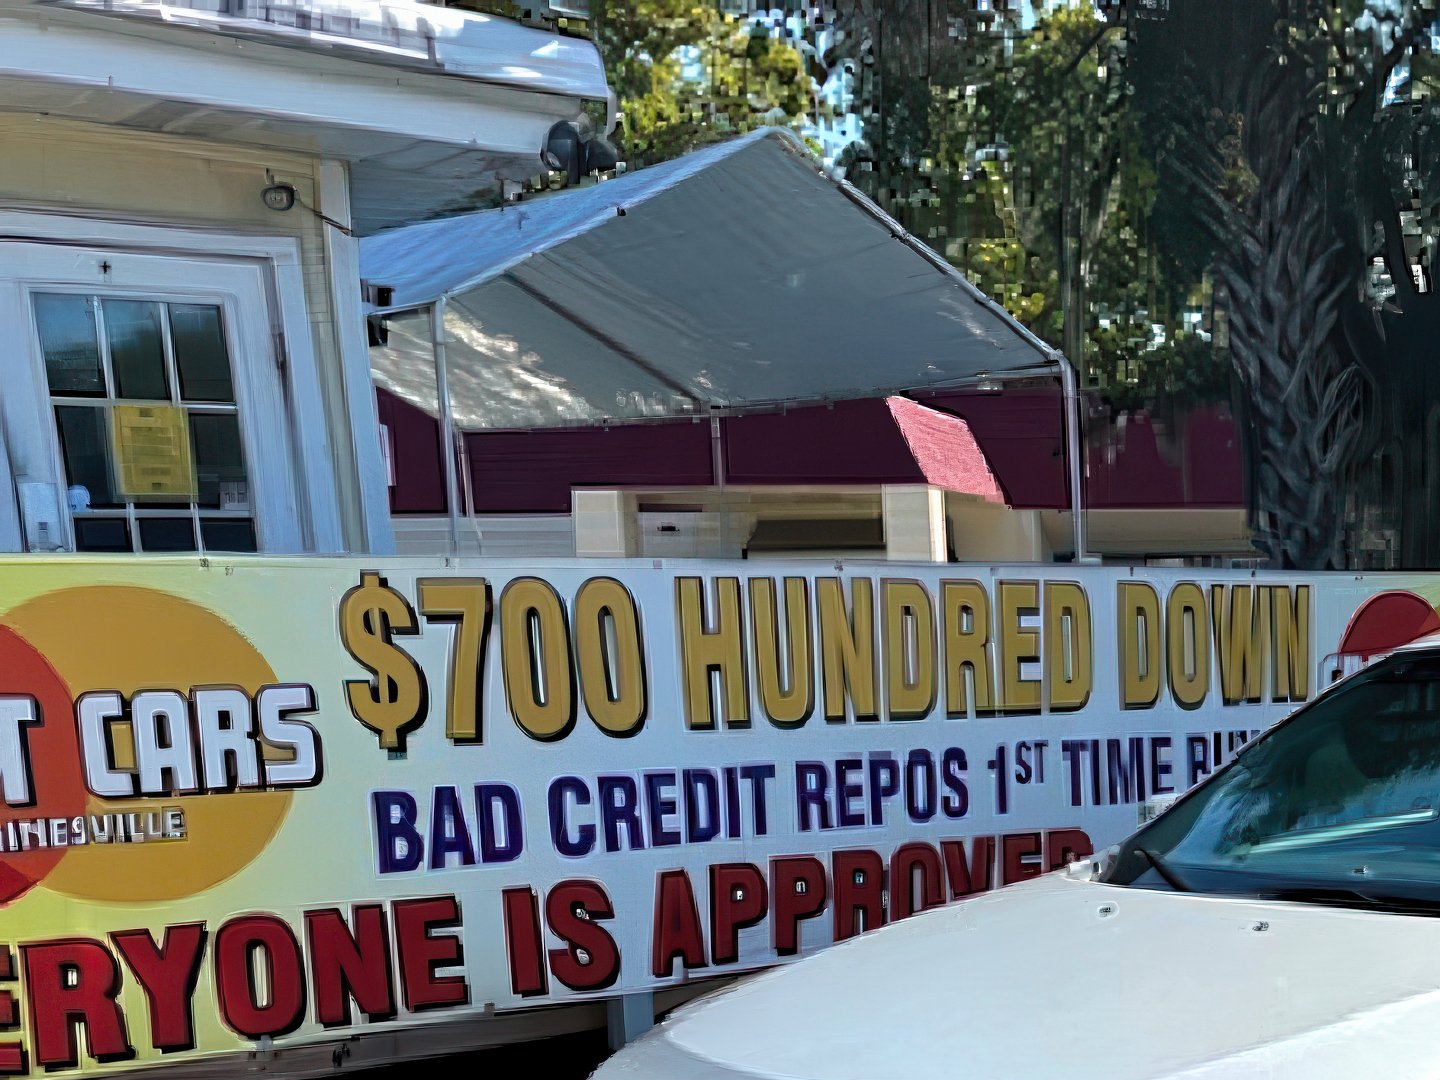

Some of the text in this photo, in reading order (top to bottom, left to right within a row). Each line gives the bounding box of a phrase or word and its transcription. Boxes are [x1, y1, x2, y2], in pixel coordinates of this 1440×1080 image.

[338, 571, 1313, 757] $700 HUNDRED DOWN
[74, 683, 324, 799] CARS
[0, 807, 187, 852] INESVILLE
[373, 780, 523, 873] BAD
[548, 764, 775, 854] CREDIT
[799, 746, 970, 831] REPOS
[1061, 736, 1175, 807] TIME
[502, 880, 621, 995] IS
